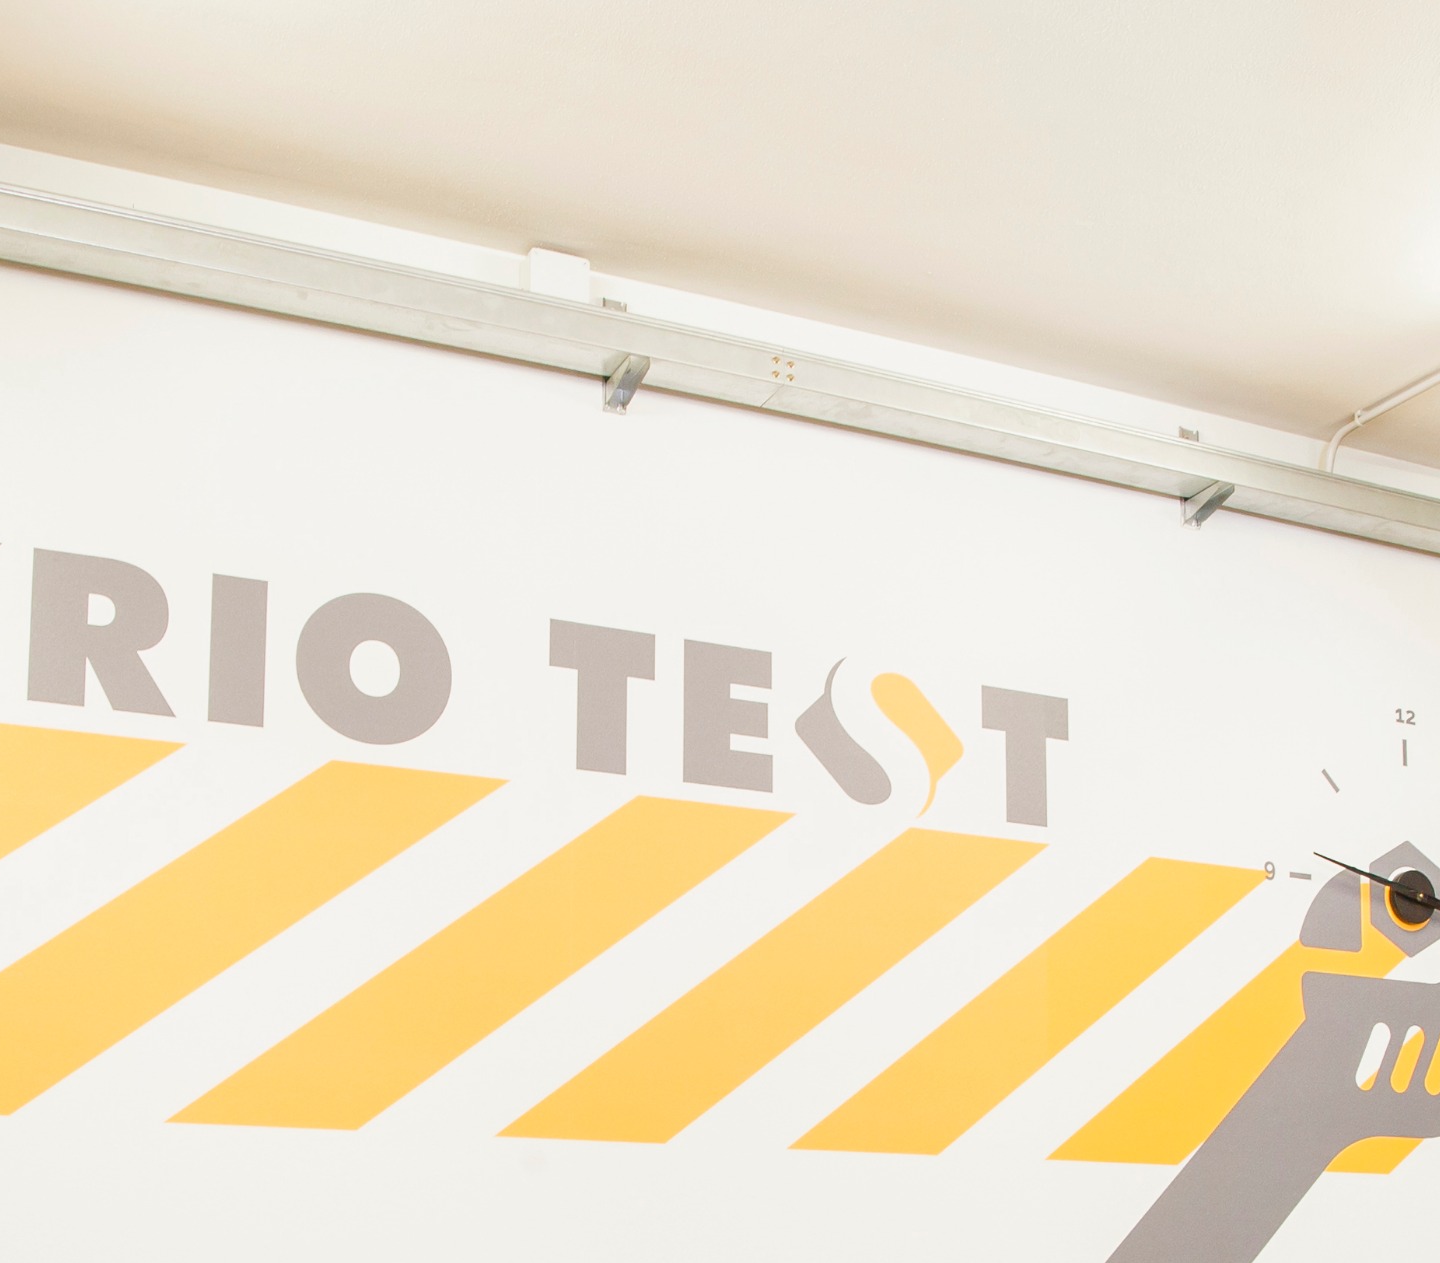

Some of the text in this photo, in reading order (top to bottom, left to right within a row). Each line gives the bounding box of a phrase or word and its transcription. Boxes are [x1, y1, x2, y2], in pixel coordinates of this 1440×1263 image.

[549, 618, 1069, 828] TEST
[1395, 708, 1416, 726] 12
[1264, 861, 1276, 881] 9
